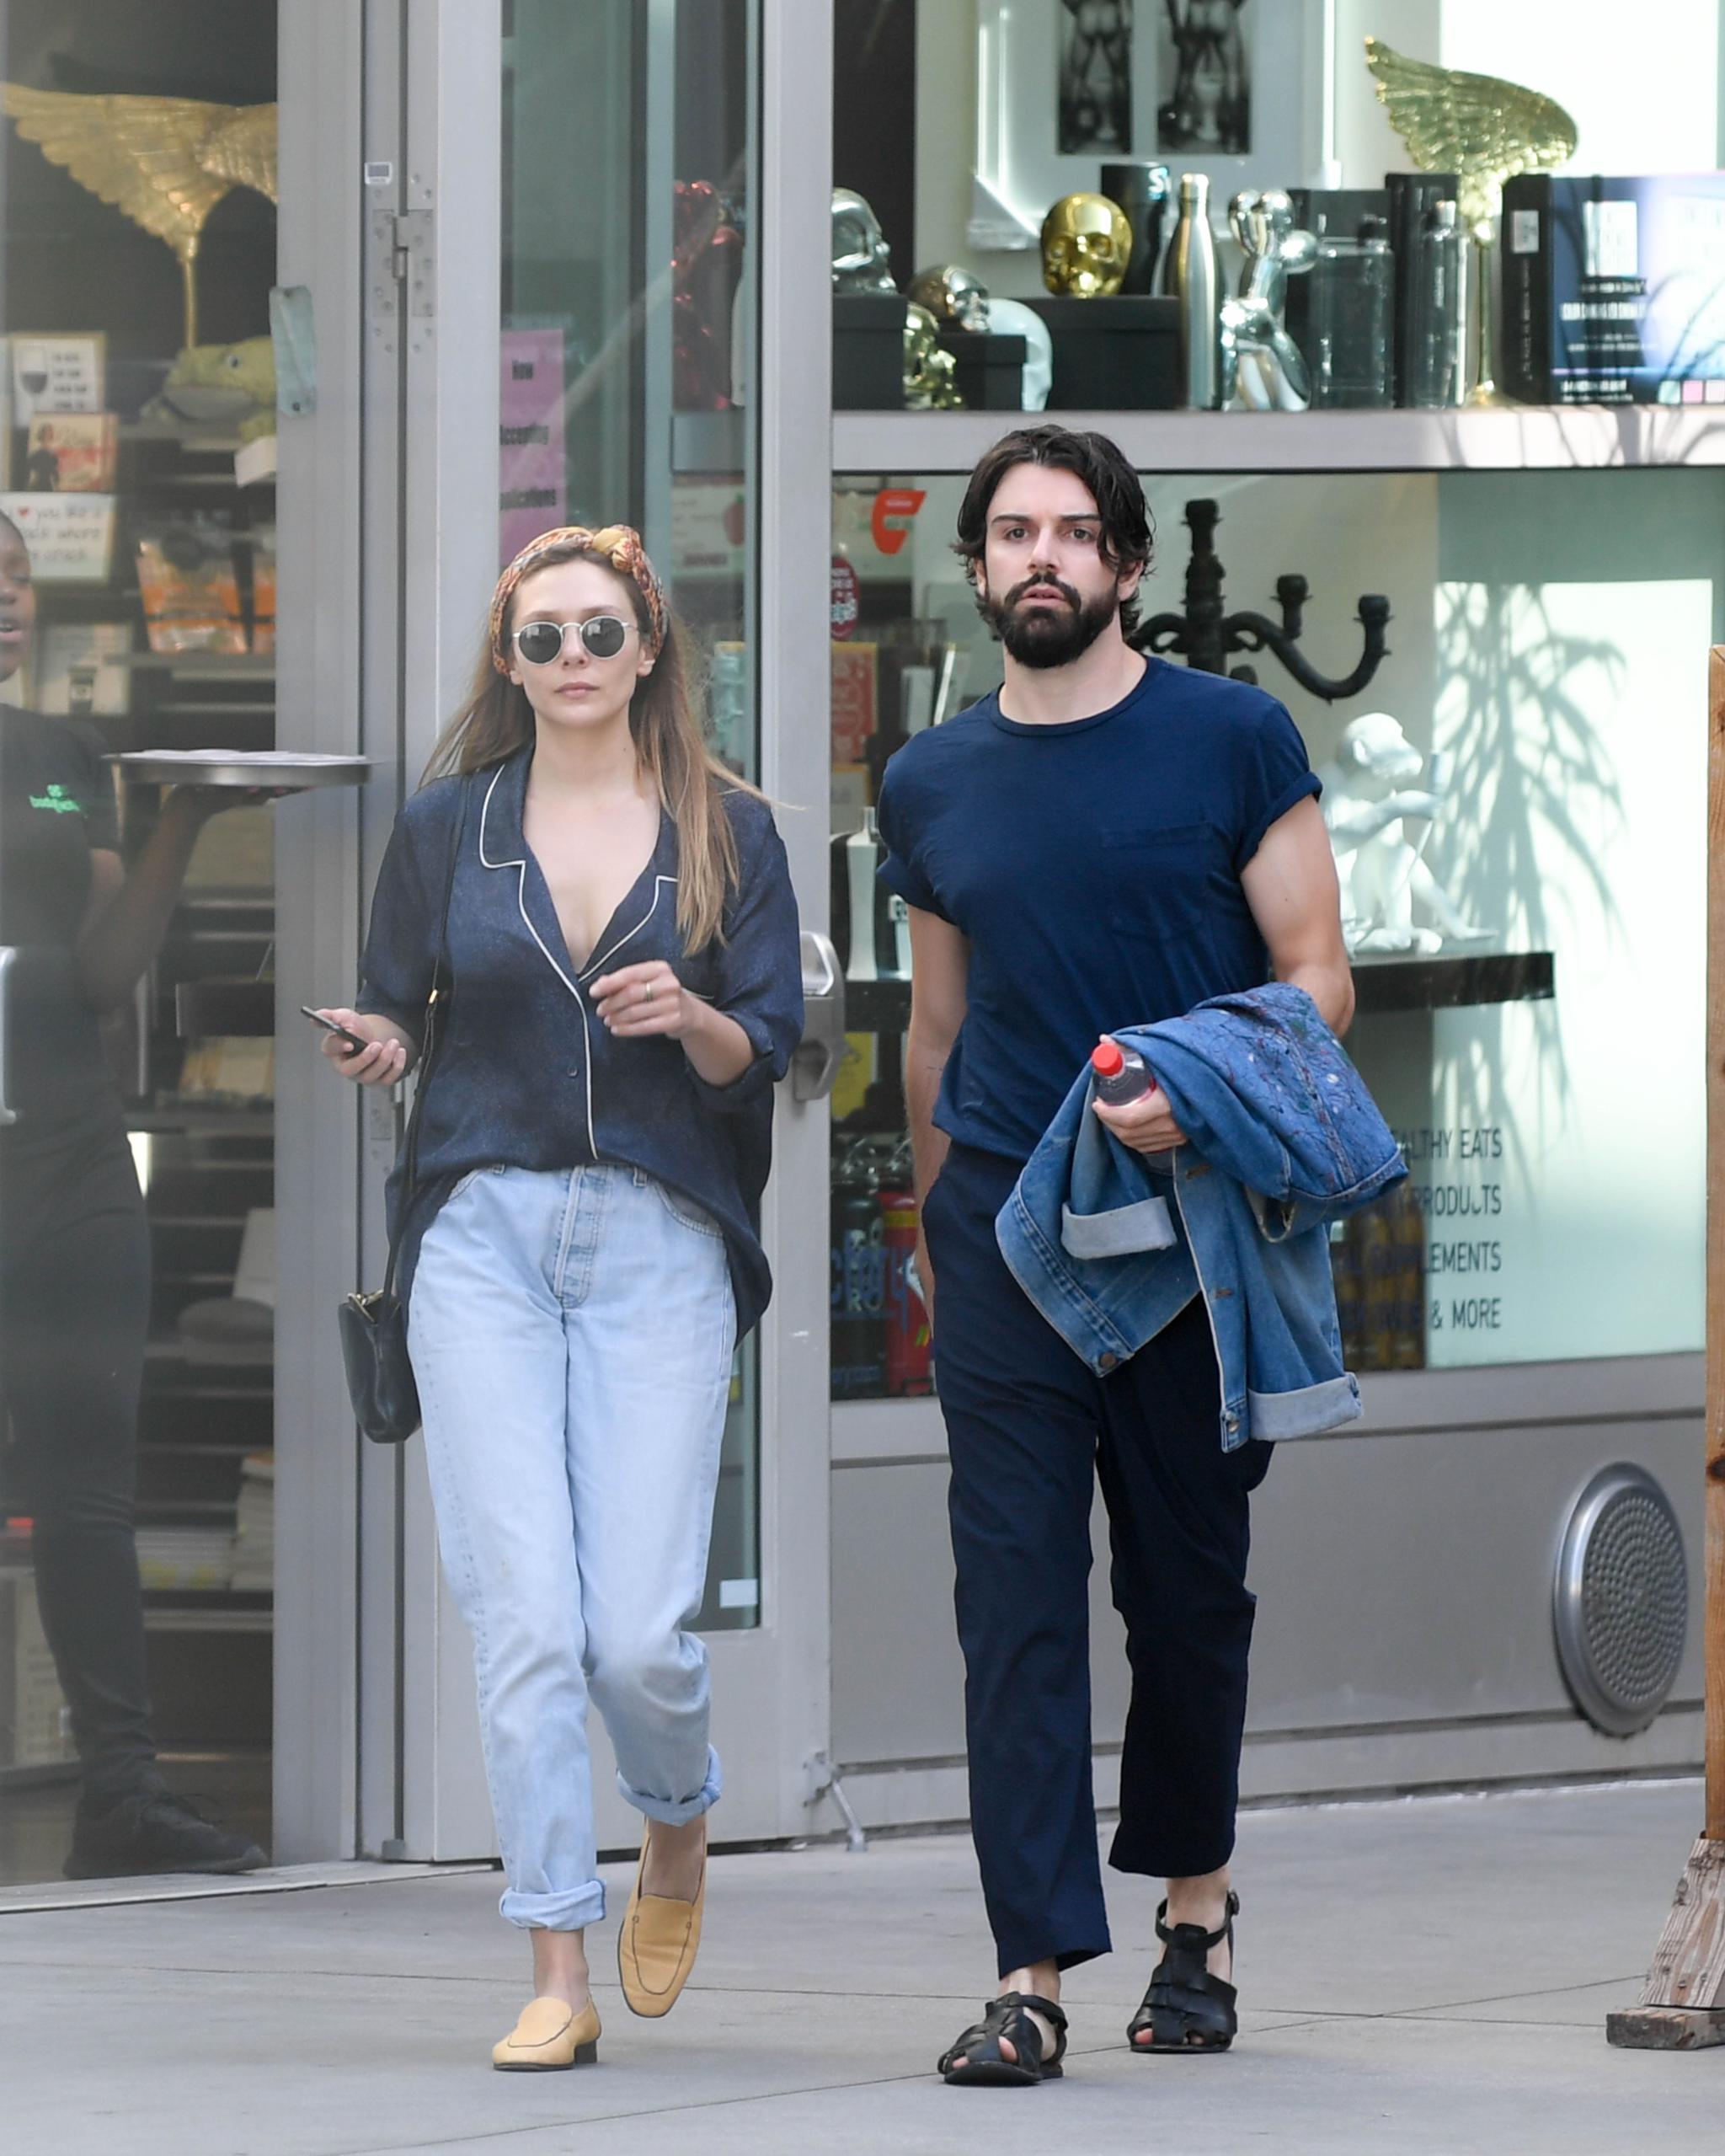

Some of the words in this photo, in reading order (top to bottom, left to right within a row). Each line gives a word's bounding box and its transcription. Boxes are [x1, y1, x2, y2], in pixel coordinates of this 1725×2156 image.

[1461, 1126, 1502, 1158] EATS
[1431, 1299, 1443, 1329] &
[1452, 1298, 1502, 1329] MORE
